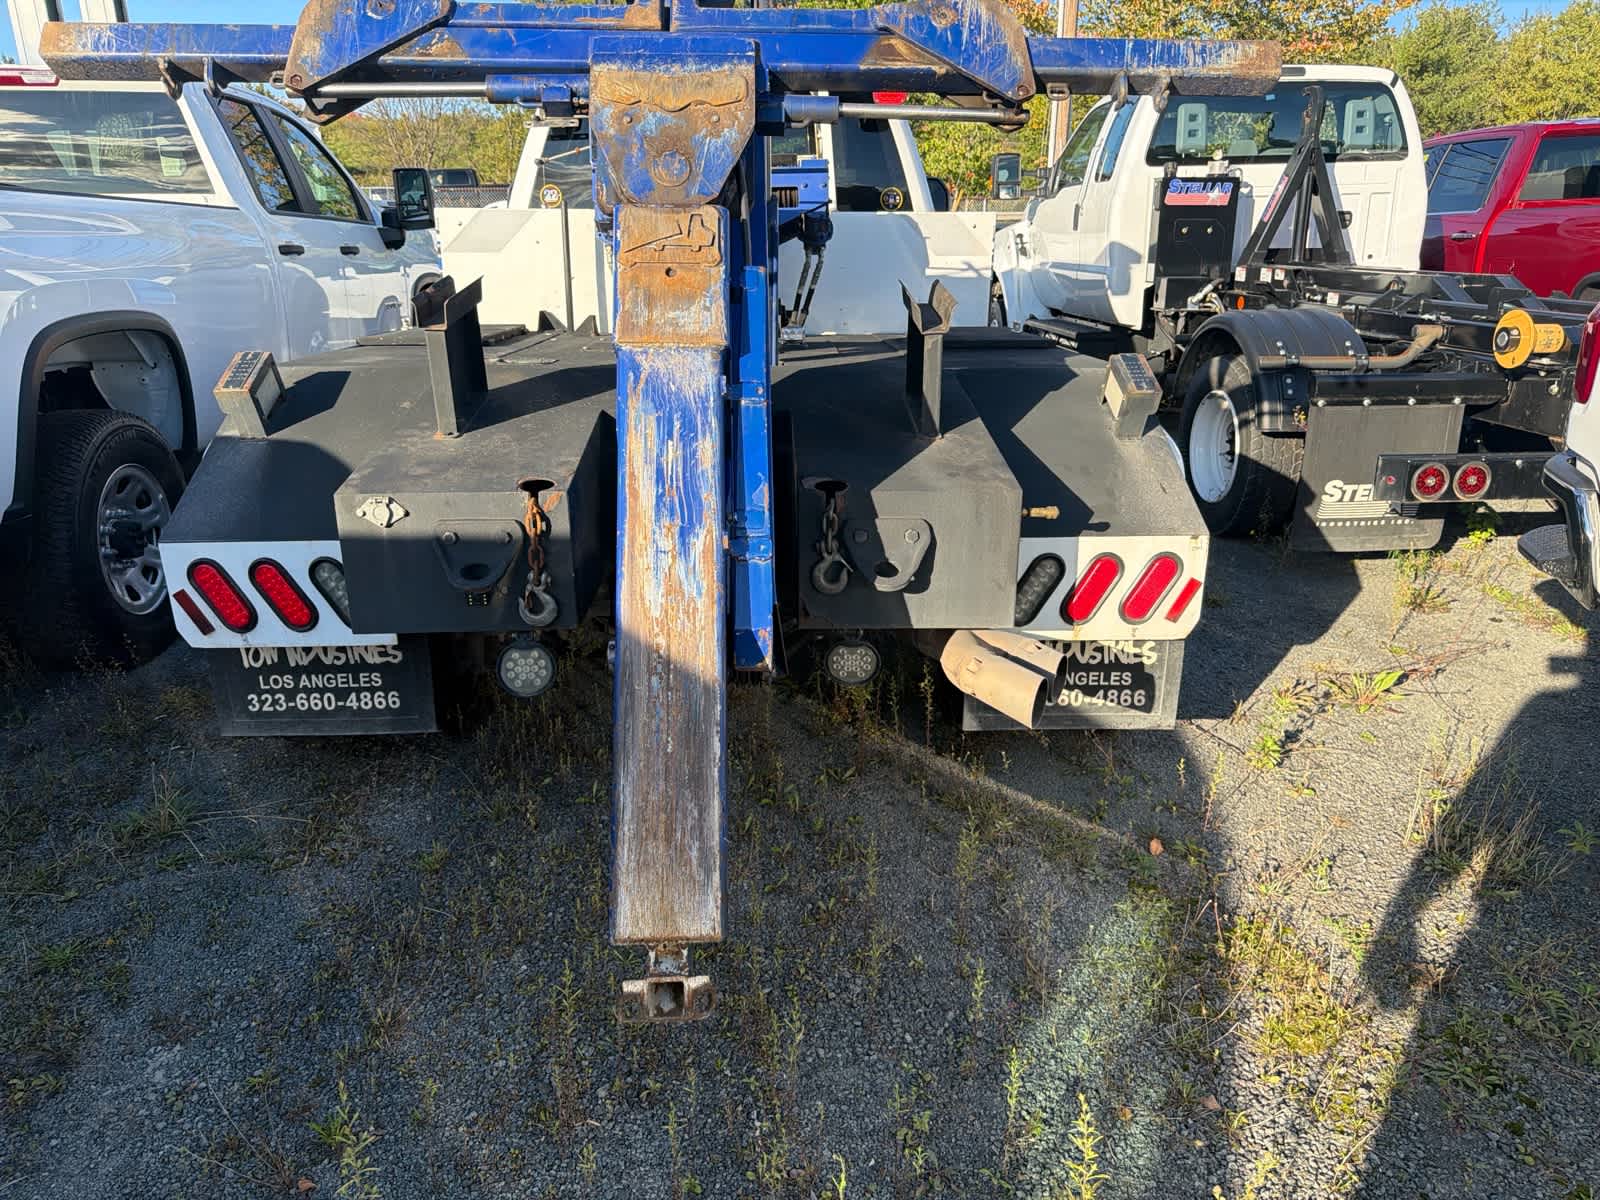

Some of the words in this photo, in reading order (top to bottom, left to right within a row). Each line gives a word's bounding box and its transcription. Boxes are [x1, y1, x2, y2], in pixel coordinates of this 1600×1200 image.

[1168, 179, 1234, 194] STELLAR
[259, 675, 294, 689] LOS
[299, 673, 382, 688] ANGELES
[1064, 671, 1132, 686] NGELES
[247, 691, 401, 711] 323-660-4866
[1046, 688, 1146, 707] 60-4866
